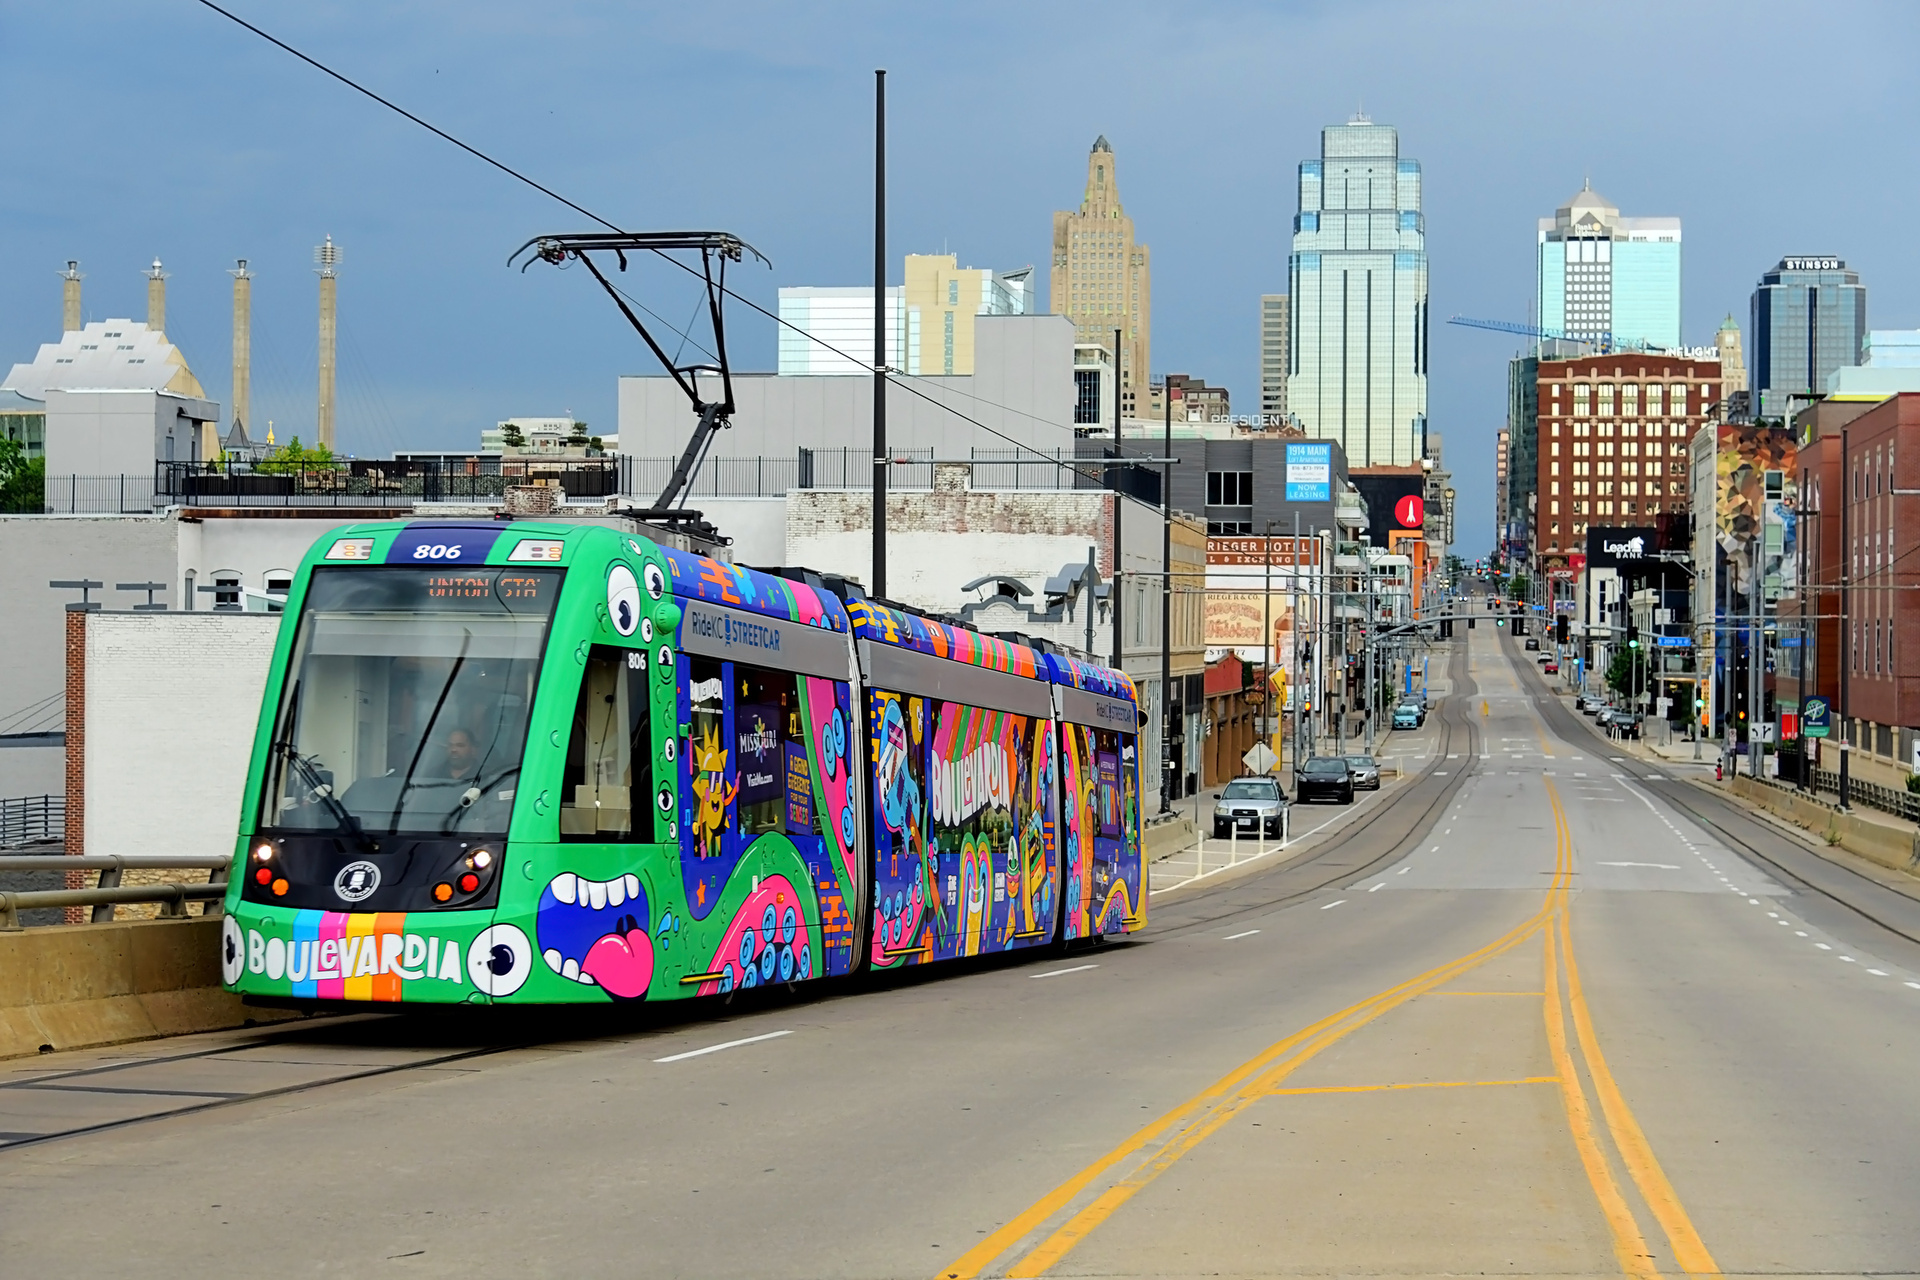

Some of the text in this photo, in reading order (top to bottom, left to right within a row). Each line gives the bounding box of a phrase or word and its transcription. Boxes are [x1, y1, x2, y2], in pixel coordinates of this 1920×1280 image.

[1786, 260, 1838, 270] STINSON
[1211, 414, 1288, 426] PRESIDENT
[1289, 446, 1327, 456] 1914 MAIN
[1289, 491, 1326, 499] LEASING
[413, 544, 462, 560] 806
[1207, 541, 1258, 552] RIEGER
[1603, 539, 1632, 553] Lead
[692, 611, 780, 652] RideKC STREETCAR
[628, 652, 647, 670] 806
